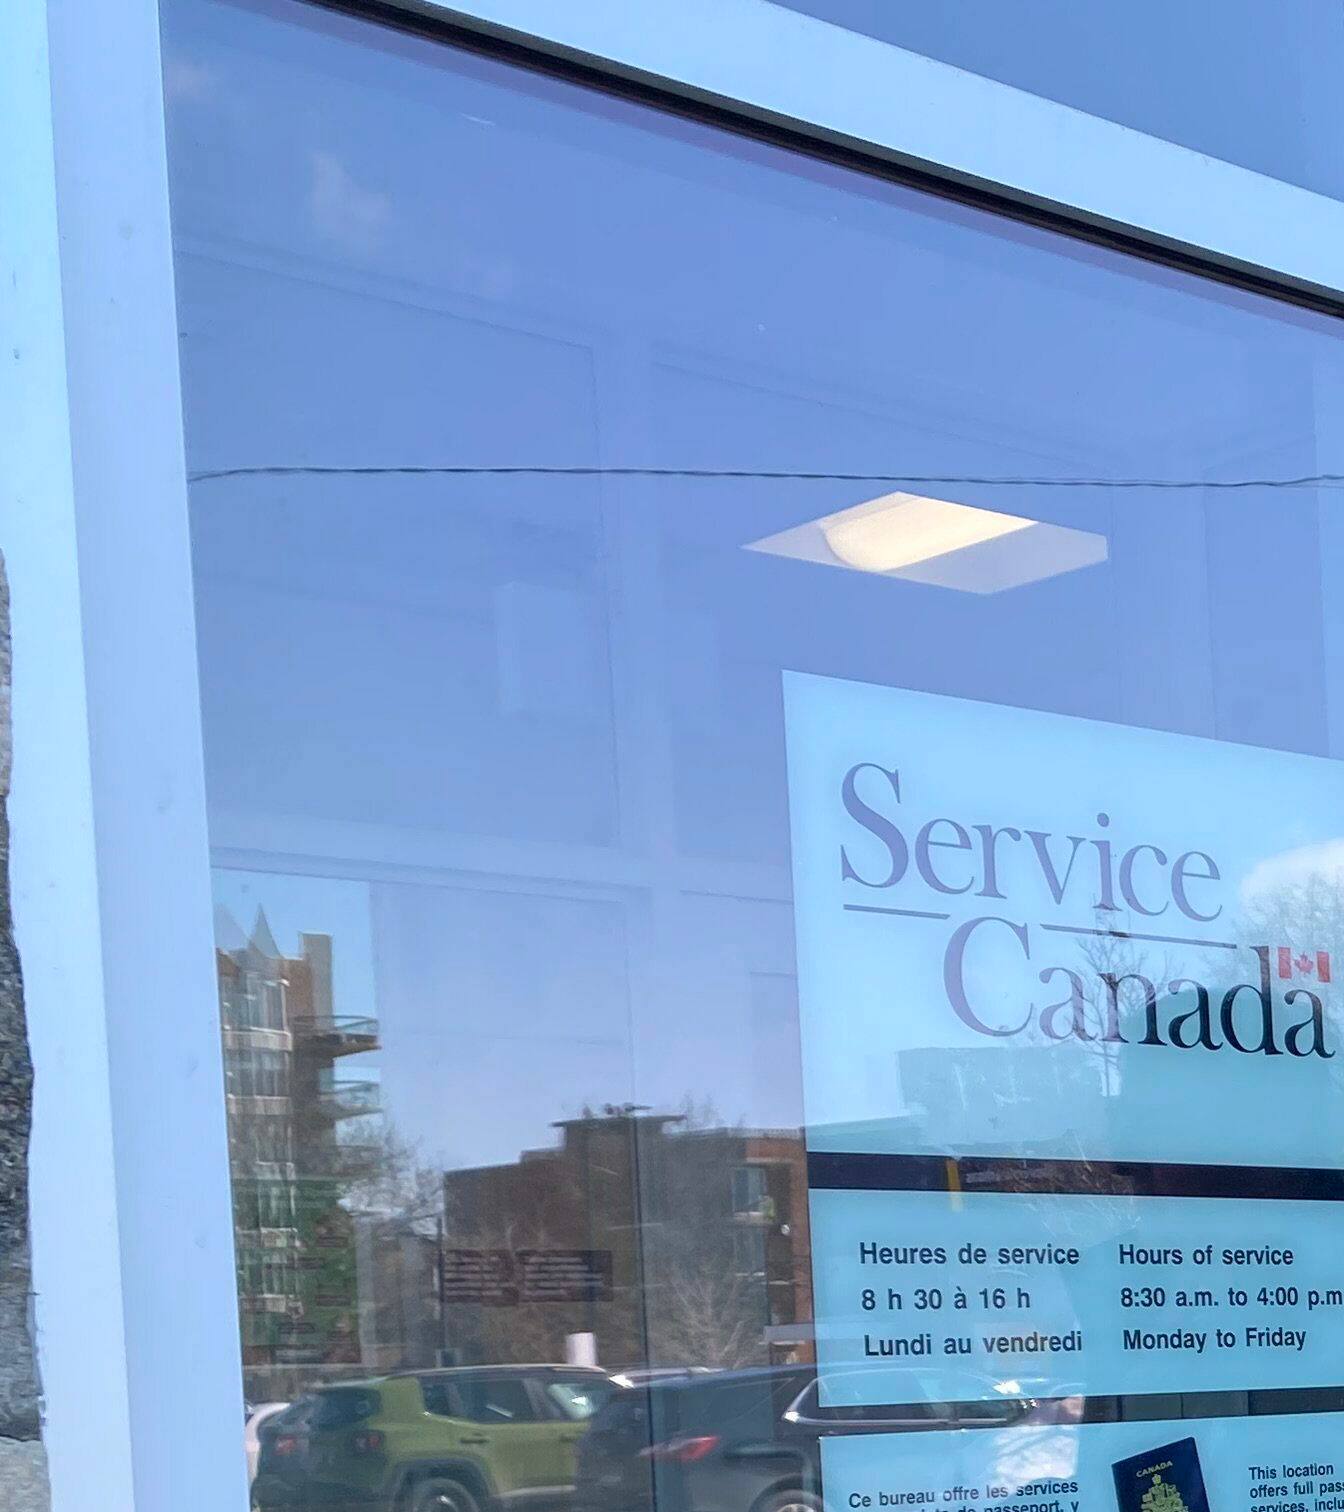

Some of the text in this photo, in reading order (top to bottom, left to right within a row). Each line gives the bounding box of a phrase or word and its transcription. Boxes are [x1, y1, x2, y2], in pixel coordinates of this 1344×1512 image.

[840, 763, 1221, 922] Service
[944, 916, 1335, 1058] Canada
[860, 1242, 1080, 1265] Heures de service
[1119, 1244, 1293, 1265] Hours of service
[861, 1286, 1030, 1311] 8 h 30 à 16 h
[1121, 1287, 1165, 1308] 8:30
[1175, 1290, 1219, 1307] a.m.
[1228, 1288, 1248, 1306] to
[1257, 1287, 1298, 1306] 4:00
[864, 1331, 1082, 1356] Lundi au vendredi
[1123, 1327, 1306, 1354] Monday to Friday
[1136, 1460, 1173, 1477] CANADA
[1249, 1463, 1334, 1480] This location
[849, 1480, 1078, 1508] Ce bureau offre les services
[1250, 1484, 1288, 1498] offers
[1294, 1481, 1314, 1495] full
